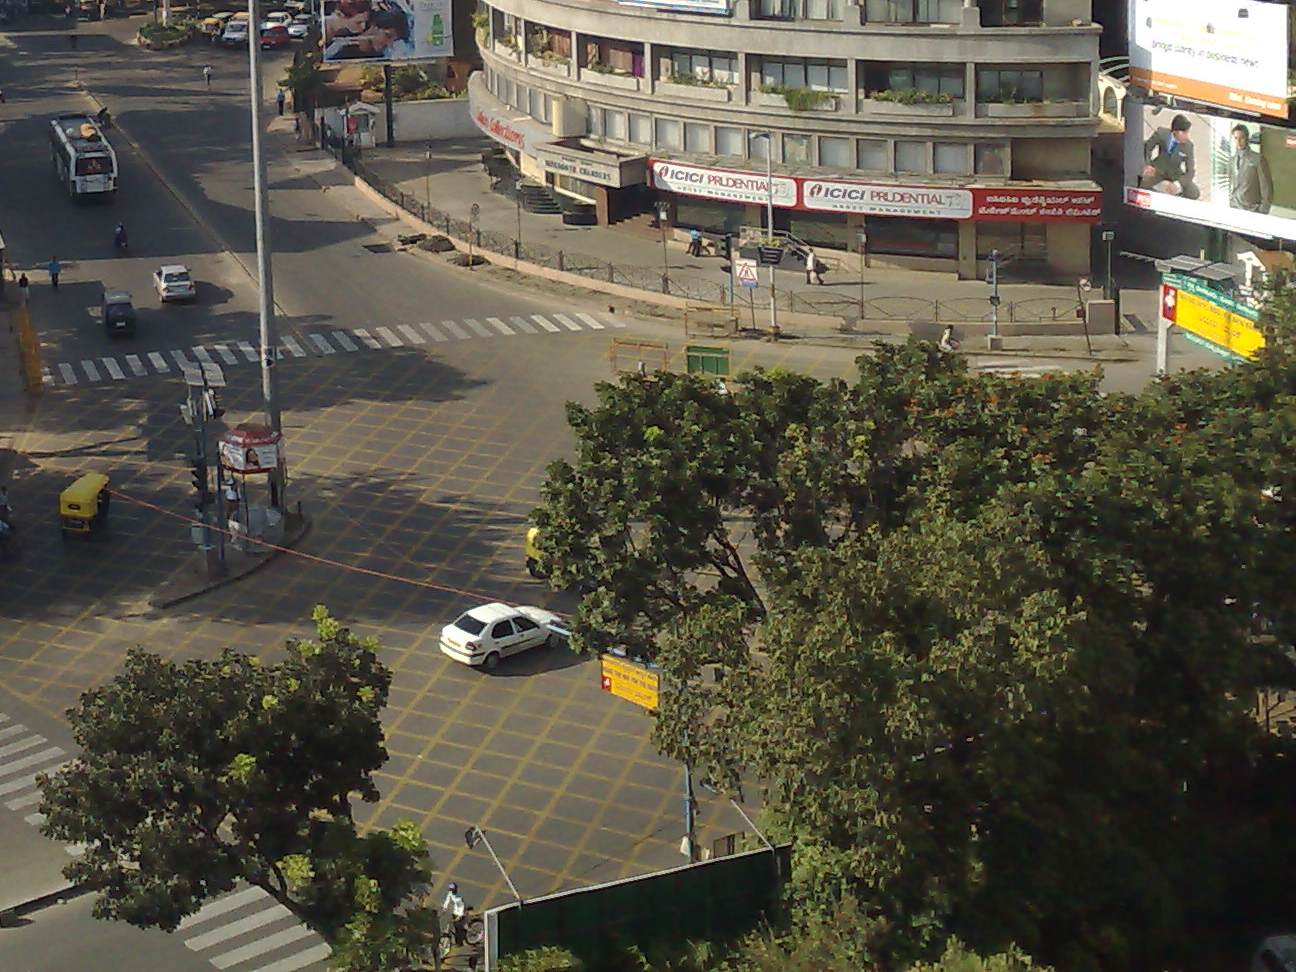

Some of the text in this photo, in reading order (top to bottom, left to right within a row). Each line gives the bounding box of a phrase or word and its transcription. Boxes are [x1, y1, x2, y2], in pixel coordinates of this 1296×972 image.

[670, 170, 704, 183] ICICI
[824, 188, 945, 205] ICICI PRUDENTIAL
